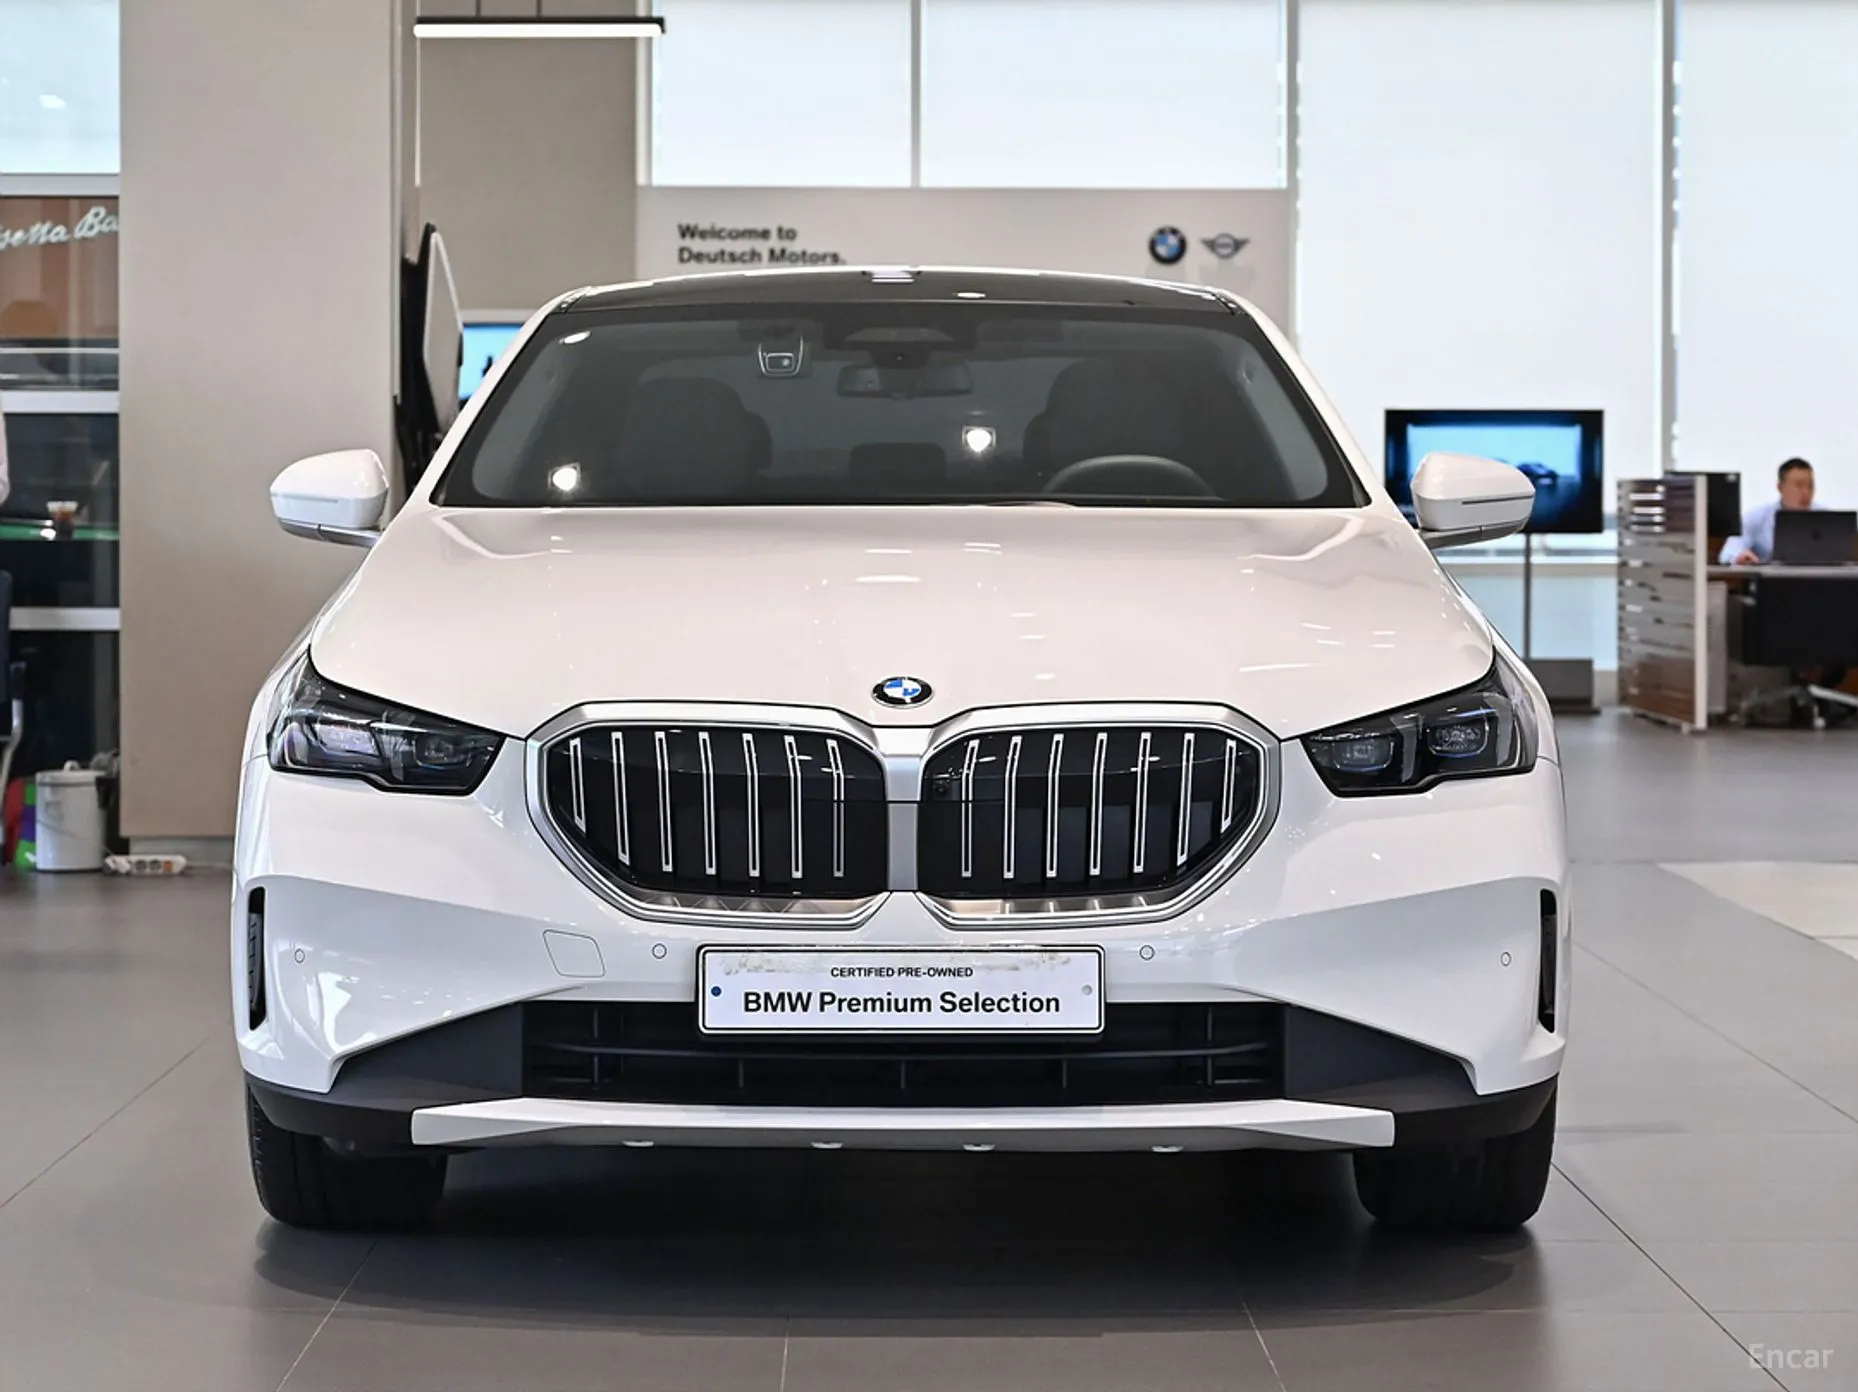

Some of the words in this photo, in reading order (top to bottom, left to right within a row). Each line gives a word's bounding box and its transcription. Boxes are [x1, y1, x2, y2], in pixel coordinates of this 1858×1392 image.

[678, 224, 771, 240] Welcome
[776, 225, 797, 240] to
[678, 248, 763, 264] Deutsch
[768, 248, 847, 265] Motors.
[830, 967, 895, 978] CERTIFIED
[898, 967, 973, 978] PRE-OWNED
[744, 991, 812, 1013] BMW
[819, 991, 932, 1013] Premium
[939, 991, 1060, 1013] Selection
